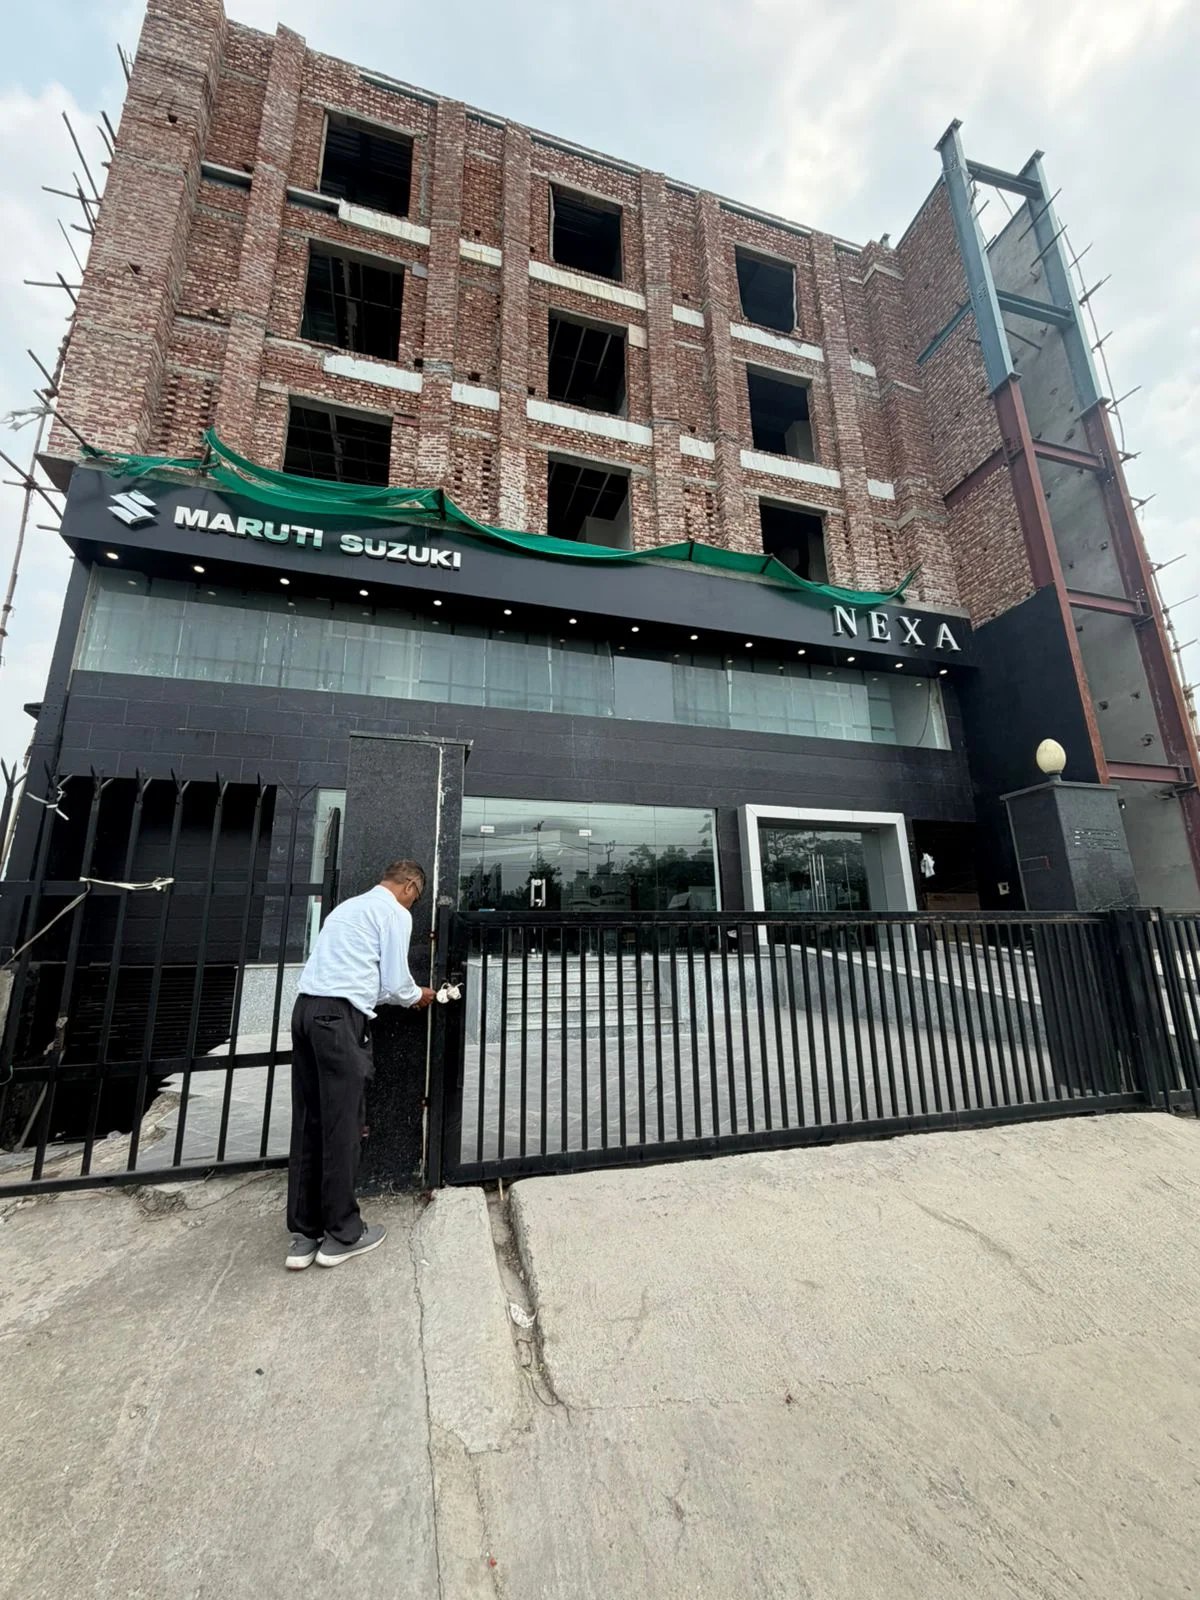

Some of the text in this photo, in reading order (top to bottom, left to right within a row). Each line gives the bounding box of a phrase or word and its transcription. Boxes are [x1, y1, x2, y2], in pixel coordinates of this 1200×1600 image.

[174, 505, 462, 569] MARUTI SUZUKI
[833, 604, 962, 651] NEXA
